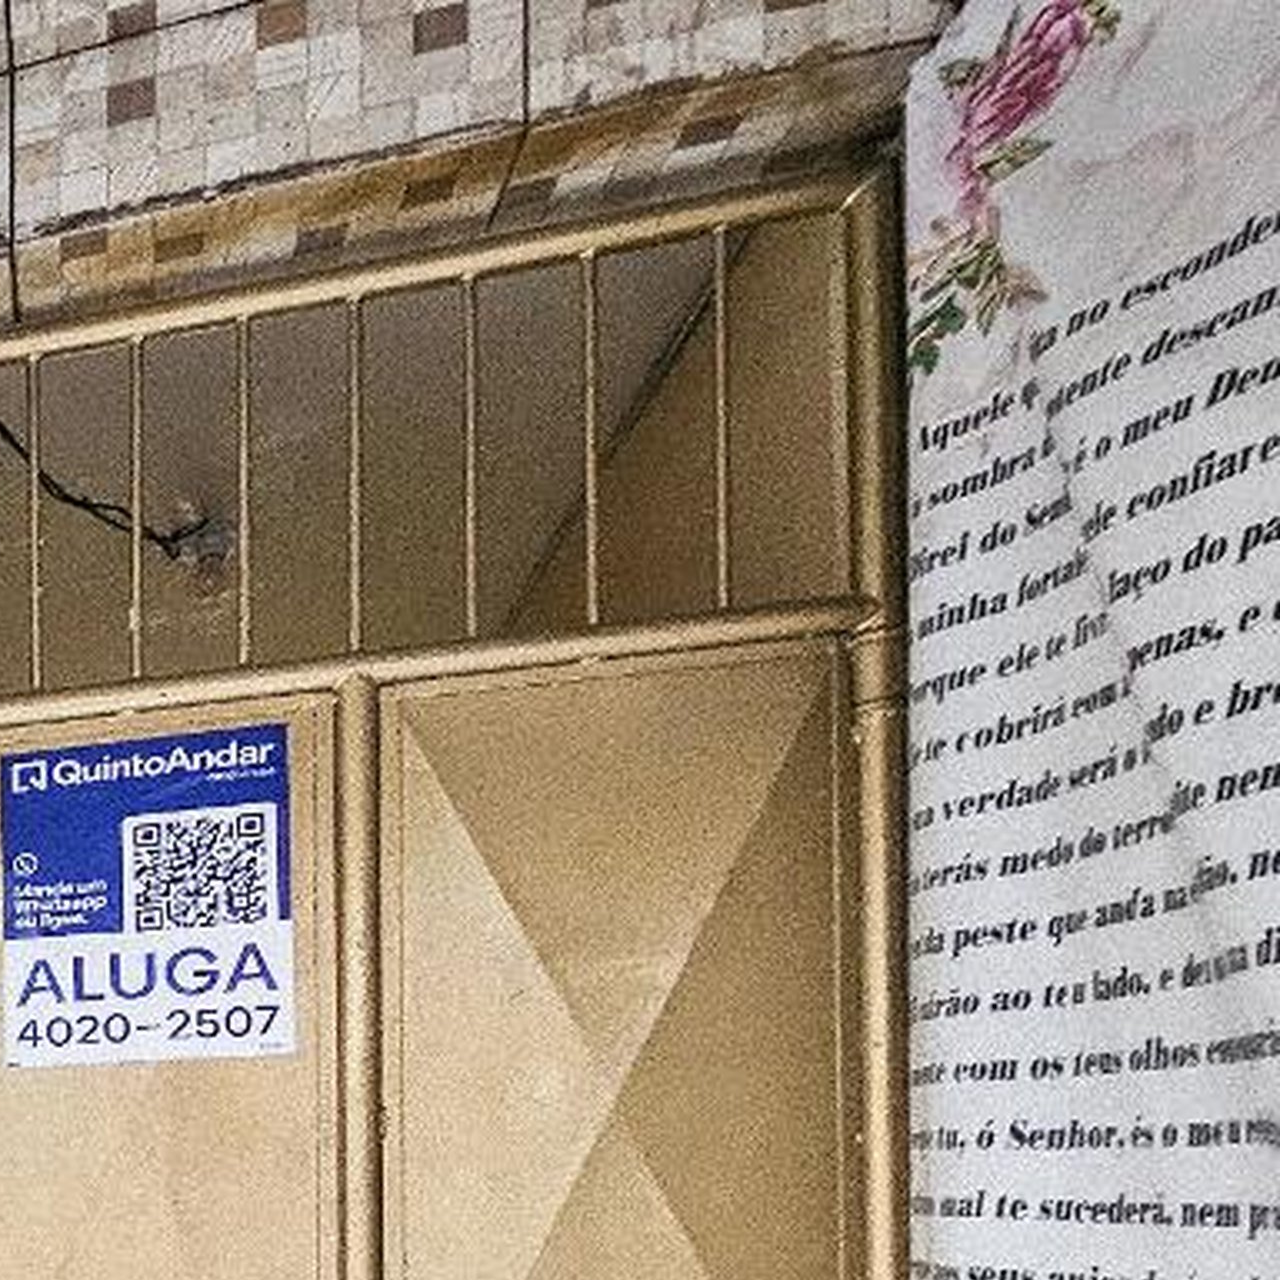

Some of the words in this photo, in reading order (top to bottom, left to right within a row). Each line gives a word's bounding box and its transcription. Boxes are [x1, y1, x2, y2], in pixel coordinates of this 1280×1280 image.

[1142, 286, 1280, 367] descan
[978, 522, 1018, 553] do
[1120, 394, 1195, 449] meu
[1126, 433, 1280, 521] confiare
[996, 644, 1040, 678] ele
[1182, 532, 1229, 574] do
[1237, 515, 1280, 565] pa
[1239, 603, 1261, 633] e
[1194, 699, 1215, 725] e
[52, 740, 276, 786] QuintoAndar
[953, 919, 1038, 958] peste
[16, 942, 279, 1008] ALUGA
[991, 989, 1032, 1013] ao
[1042, 983, 1086, 1008] teu
[16, 1005, 280, 1049] 4020-2507
[953, 1057, 1020, 1084] com
[1029, 1055, 1064, 1080] os
[1073, 1051, 1123, 1076] teus
[1129, 1036, 1201, 1072] olhos
[1161, 1123, 1179, 1147] o
[995, 1193, 1030, 1220] te
[1179, 1200, 1241, 1228] nem
